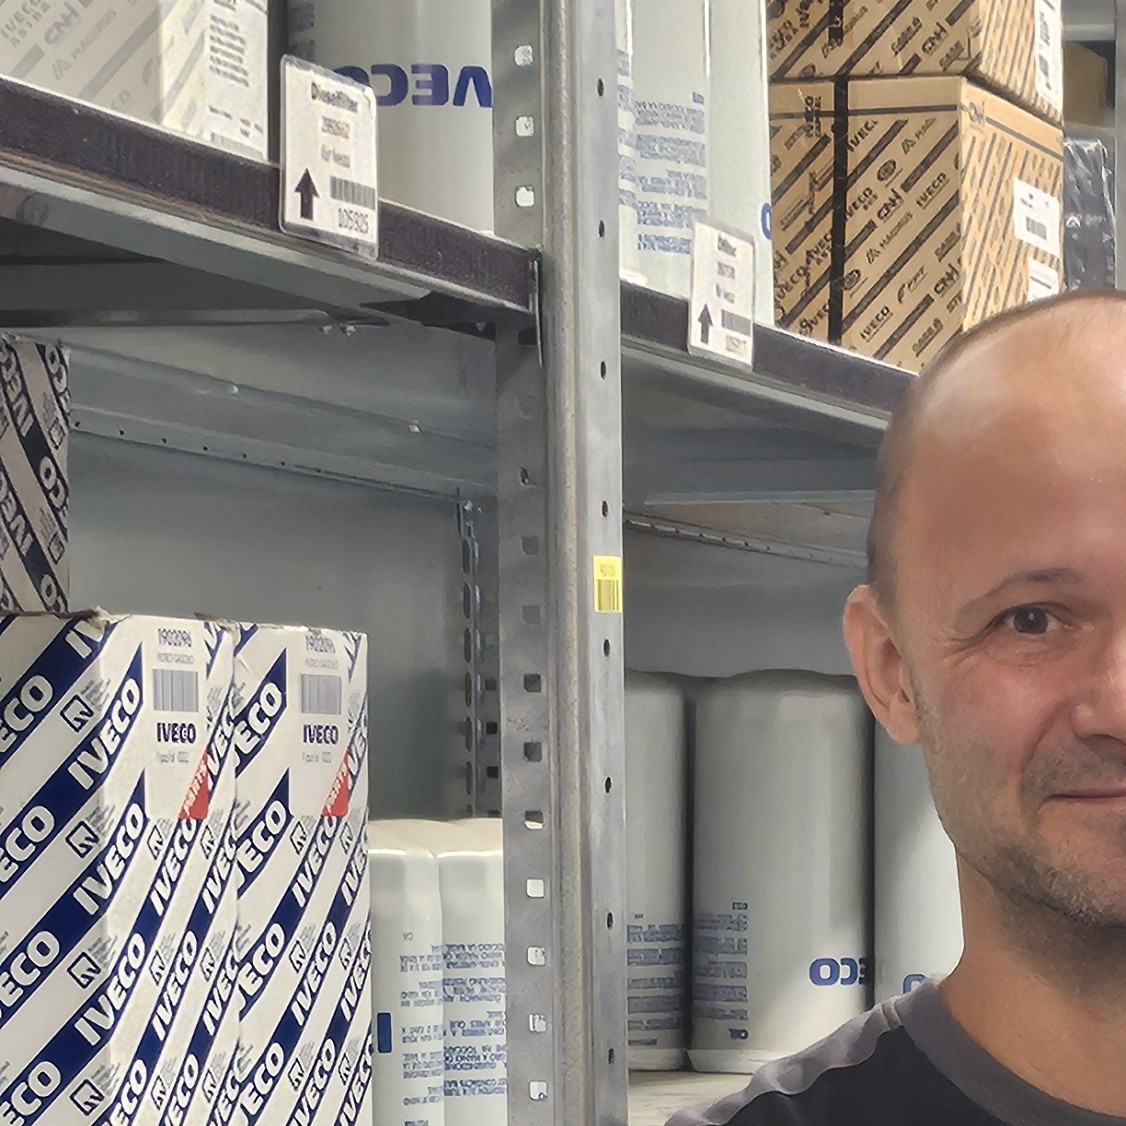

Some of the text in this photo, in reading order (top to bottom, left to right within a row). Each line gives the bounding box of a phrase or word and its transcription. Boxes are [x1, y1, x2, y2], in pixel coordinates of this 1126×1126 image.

[334, 63, 493, 108] VEC
[916, 172, 950, 209] IVECO
[860, 305, 891, 342] IVECO
[0, 675, 54, 750] ECO
[67, 678, 141, 790] IVECO
[157, 722, 197, 744] IVECO
[232, 682, 283, 770] ECO
[303, 724, 339, 745] IVECO
[0, 805, 56, 883] ECO
[73, 803, 144, 916] IVECO
[235, 800, 287, 887] ECO
[0, 930, 61, 1007] ECO
[74, 932, 146, 1046] IVECO
[152, 930, 198, 1041] IVECO
[237, 923, 286, 1010] ECO
[291, 921, 337, 1026] IVECO
